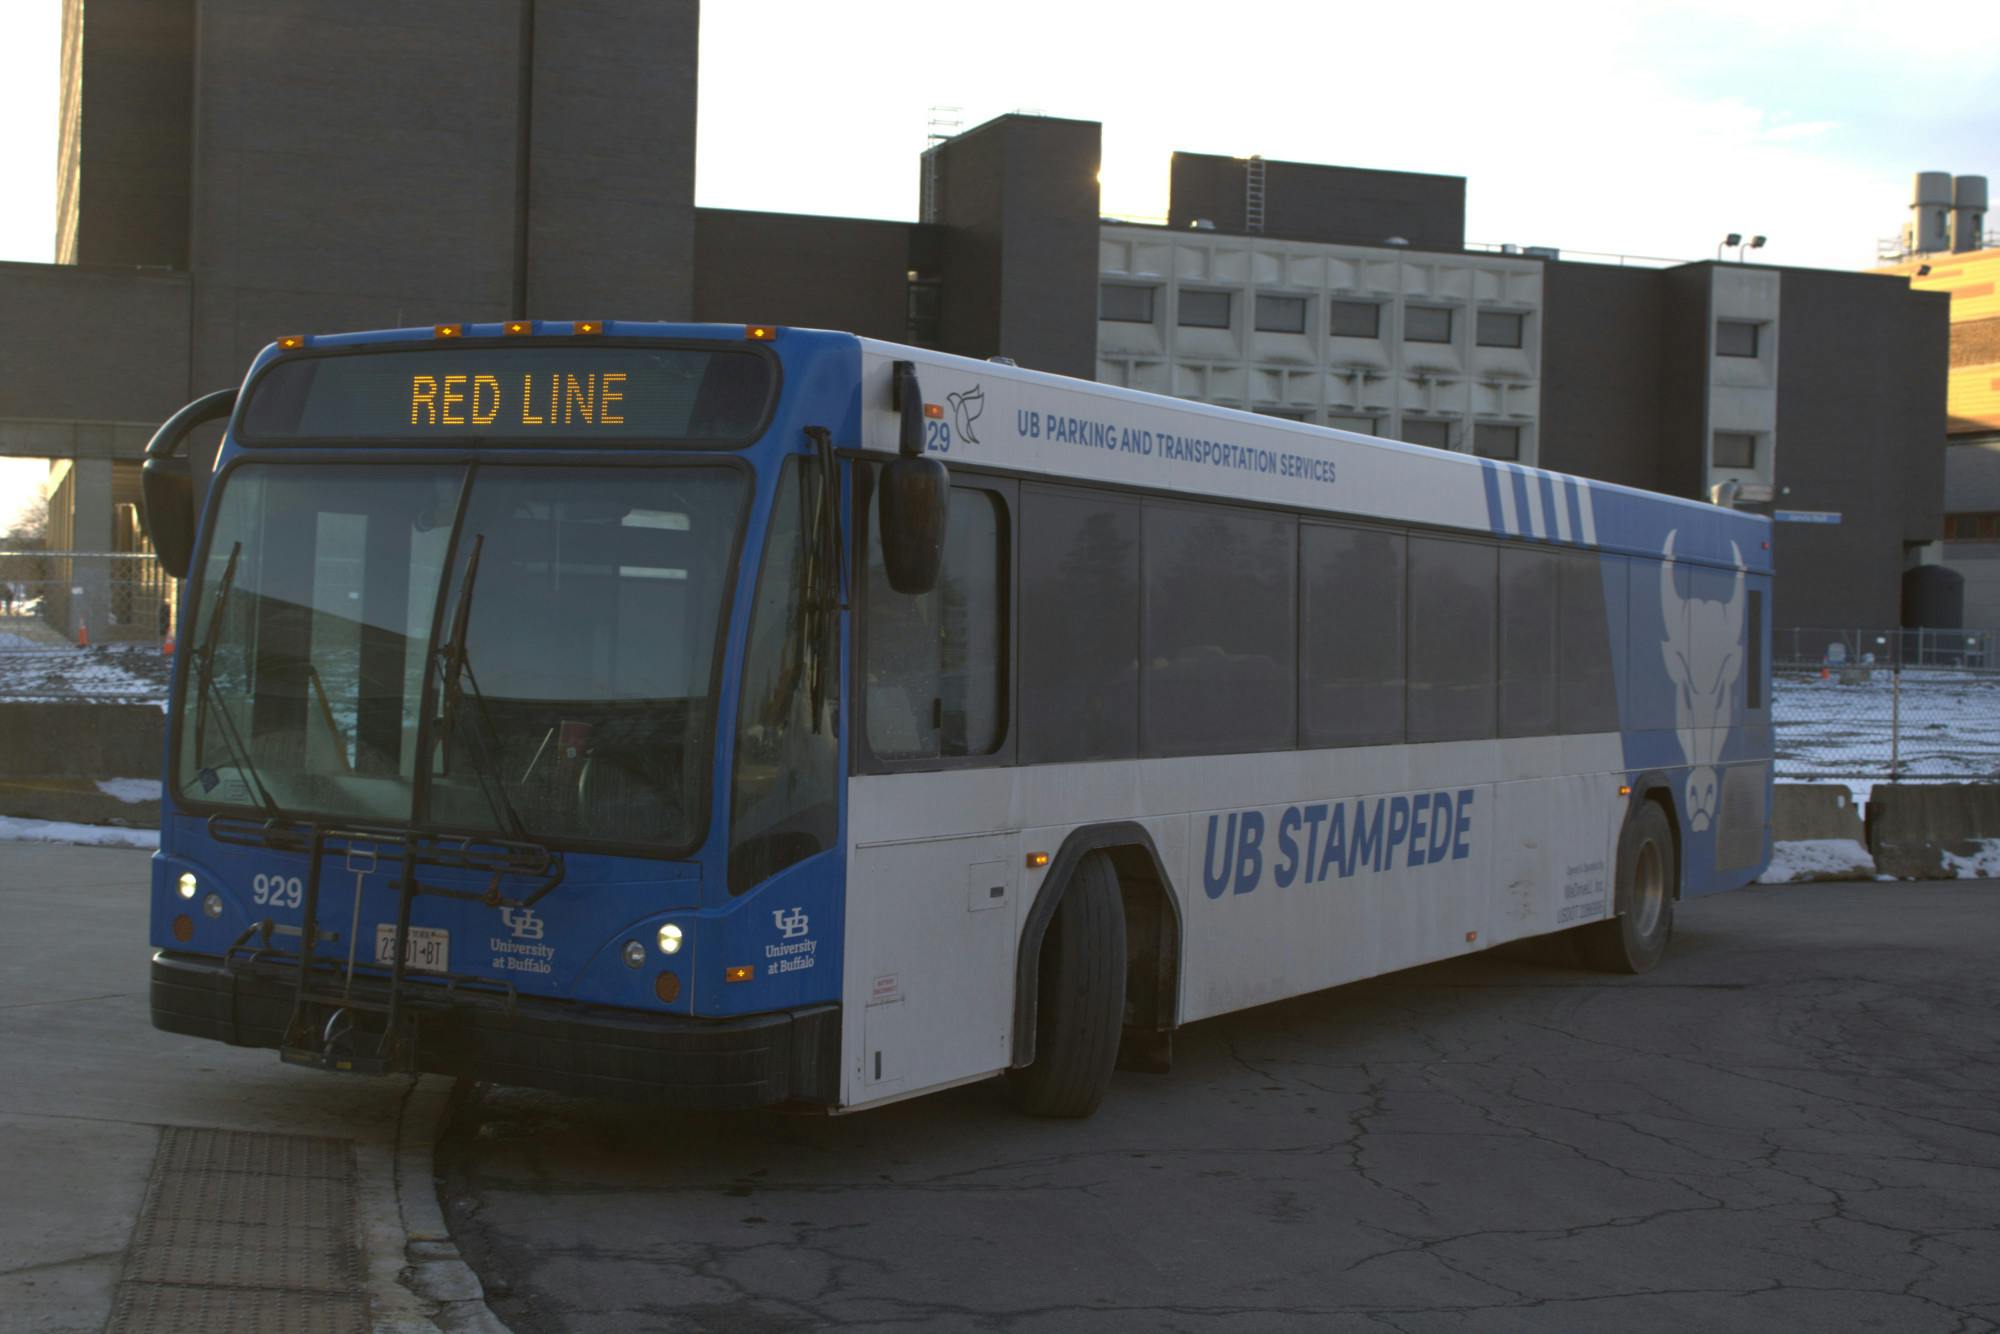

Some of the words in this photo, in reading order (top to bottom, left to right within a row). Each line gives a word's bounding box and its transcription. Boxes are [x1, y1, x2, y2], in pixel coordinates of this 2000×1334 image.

[412, 375, 500, 424] RED
[522, 373, 627, 424] LINE
[1018, 409, 1041, 438] UB
[1046, 414, 1117, 451] PARKING
[1120, 428, 1153, 456] AND
[1156, 432, 1277, 473] TRANSPORTATION
[1280, 454, 1336, 483] SERVICES
[1203, 810, 1264, 900] UB
[1274, 789, 1474, 889] STAMPEDE
[253, 873, 303, 909] 929
[490, 938, 555, 961] University
[765, 938, 818, 958] University
[492, 957, 505, 969] at
[507, 957, 552, 974] Buffalo
[768, 961, 778, 975] at
[780, 955, 815, 973] Buffalo
